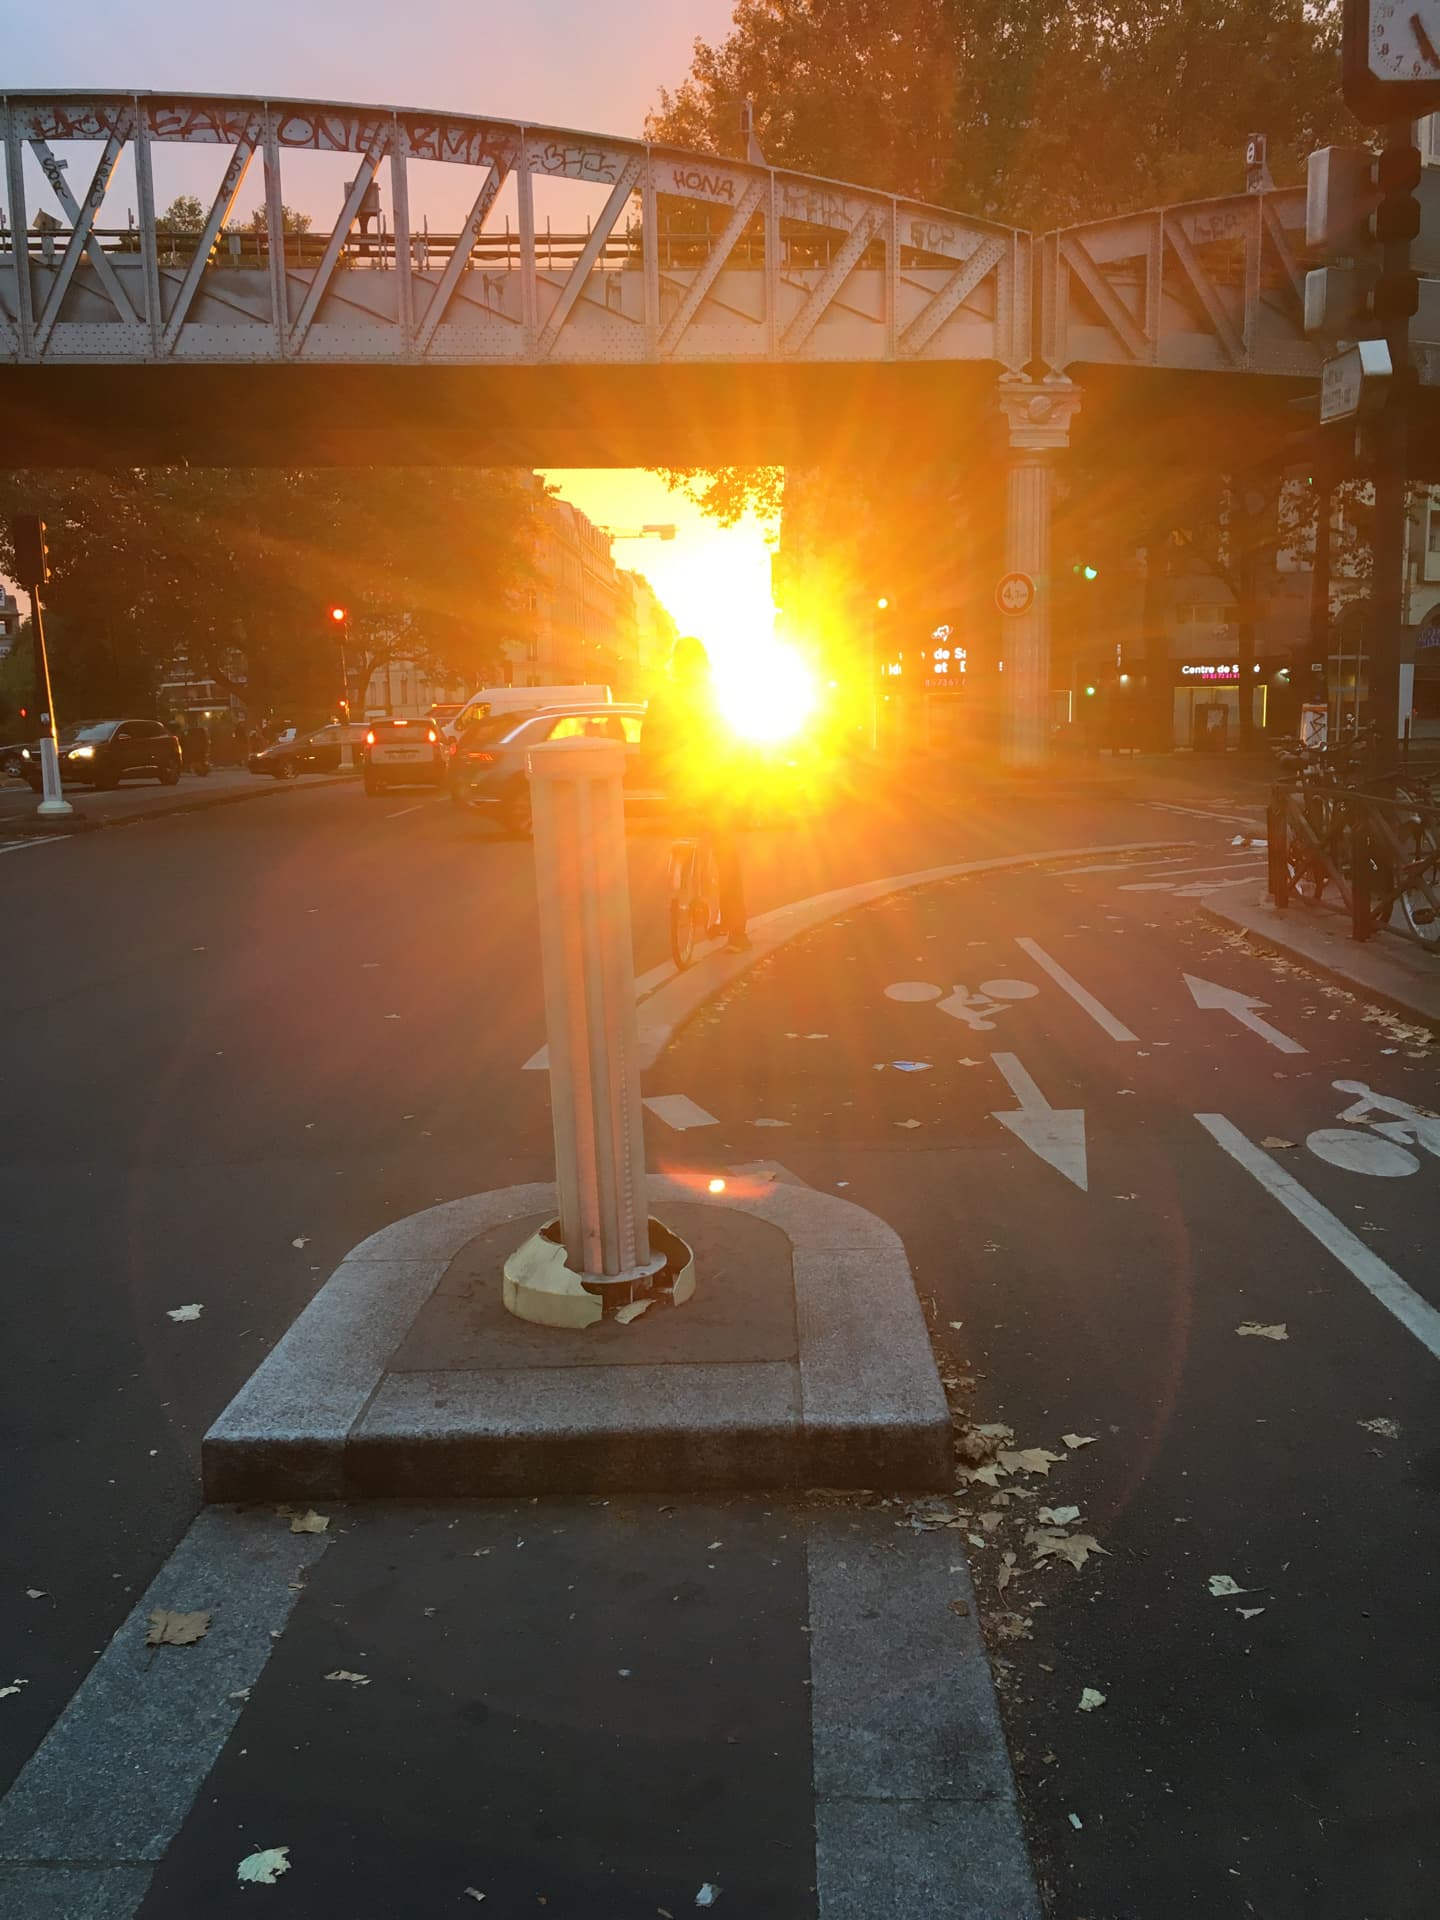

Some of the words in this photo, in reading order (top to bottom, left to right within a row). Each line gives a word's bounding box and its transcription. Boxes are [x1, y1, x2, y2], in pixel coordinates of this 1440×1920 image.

[1377, 24, 1384, 37] 9
[1382, 43, 1389, 55] 8
[1396, 55, 1404, 67] 7
[1182, 665, 1215, 675] Centre
[1217, 664, 1230, 674] de
